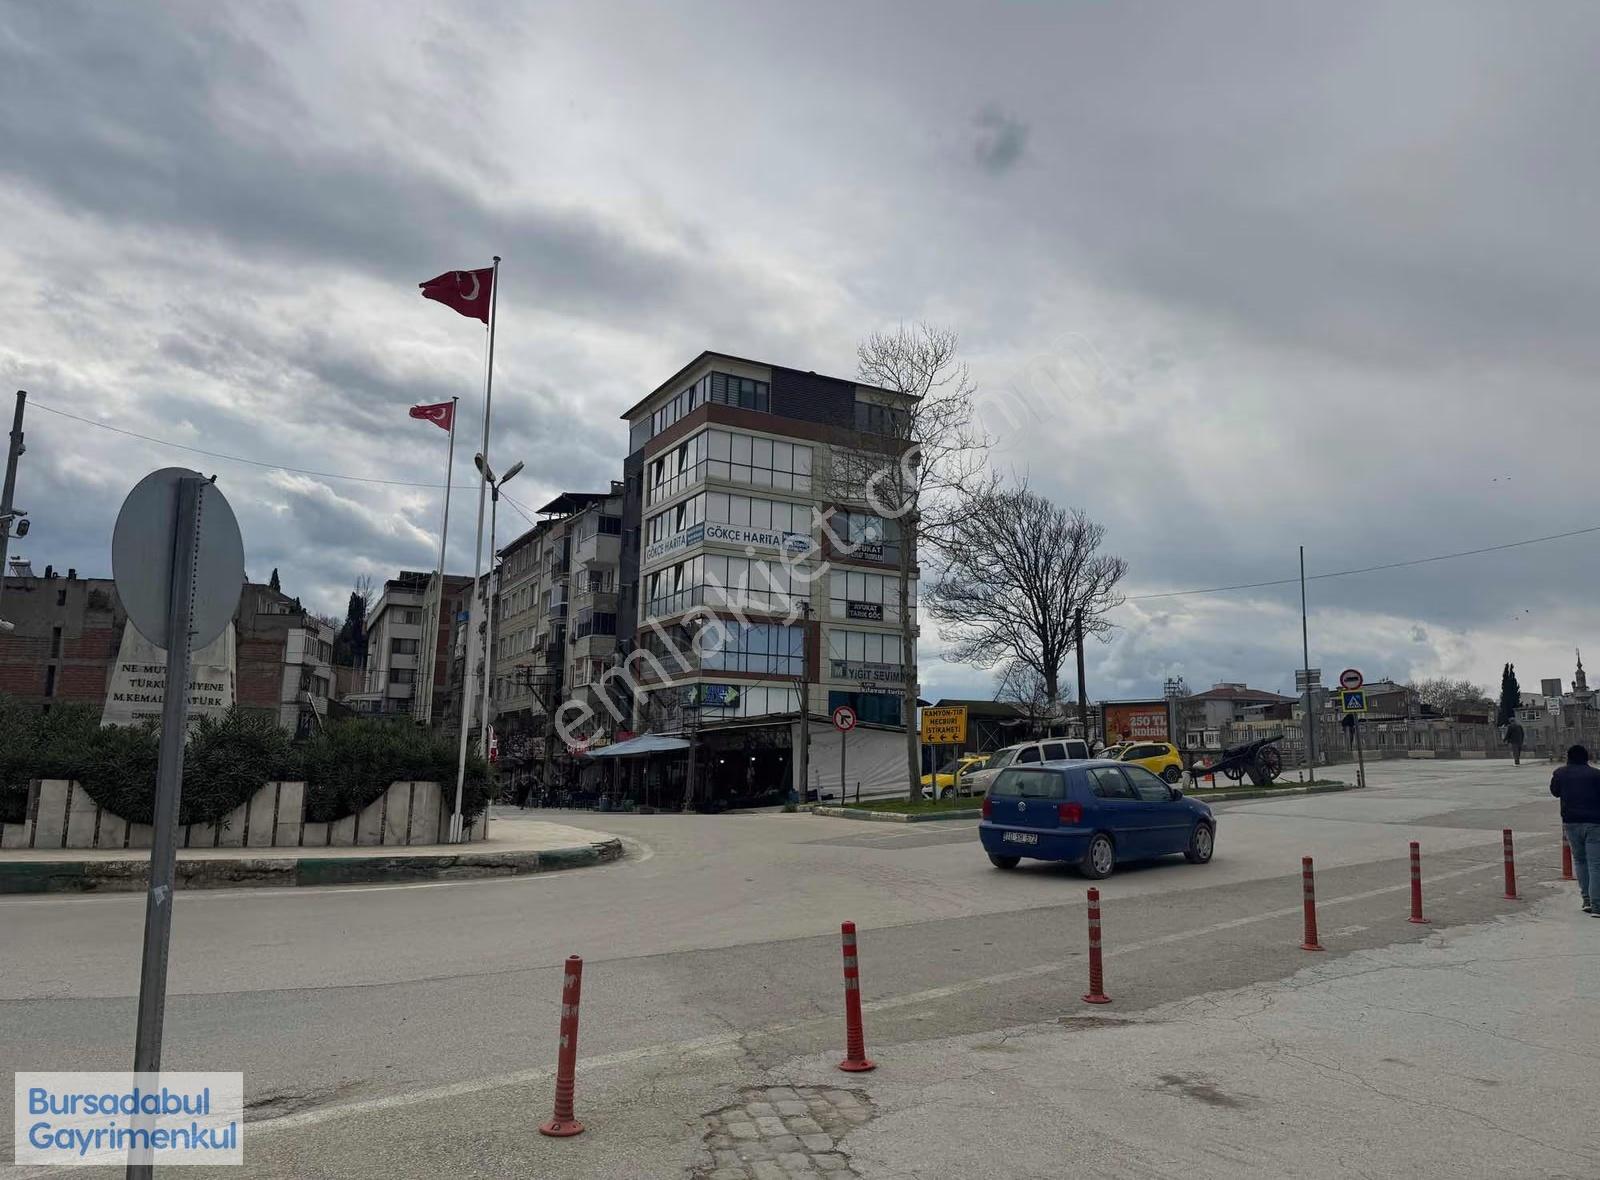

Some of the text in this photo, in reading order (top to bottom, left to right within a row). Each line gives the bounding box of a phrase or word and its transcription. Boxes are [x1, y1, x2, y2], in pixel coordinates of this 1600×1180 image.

[706, 525, 741, 542] GÖKÇE
[743, 531, 780, 546] HARİTA
[121, 664, 168, 674] NE MUT
[113, 693, 164, 704] M.KEMAL
[1129, 715, 1168, 727] 250 TL
